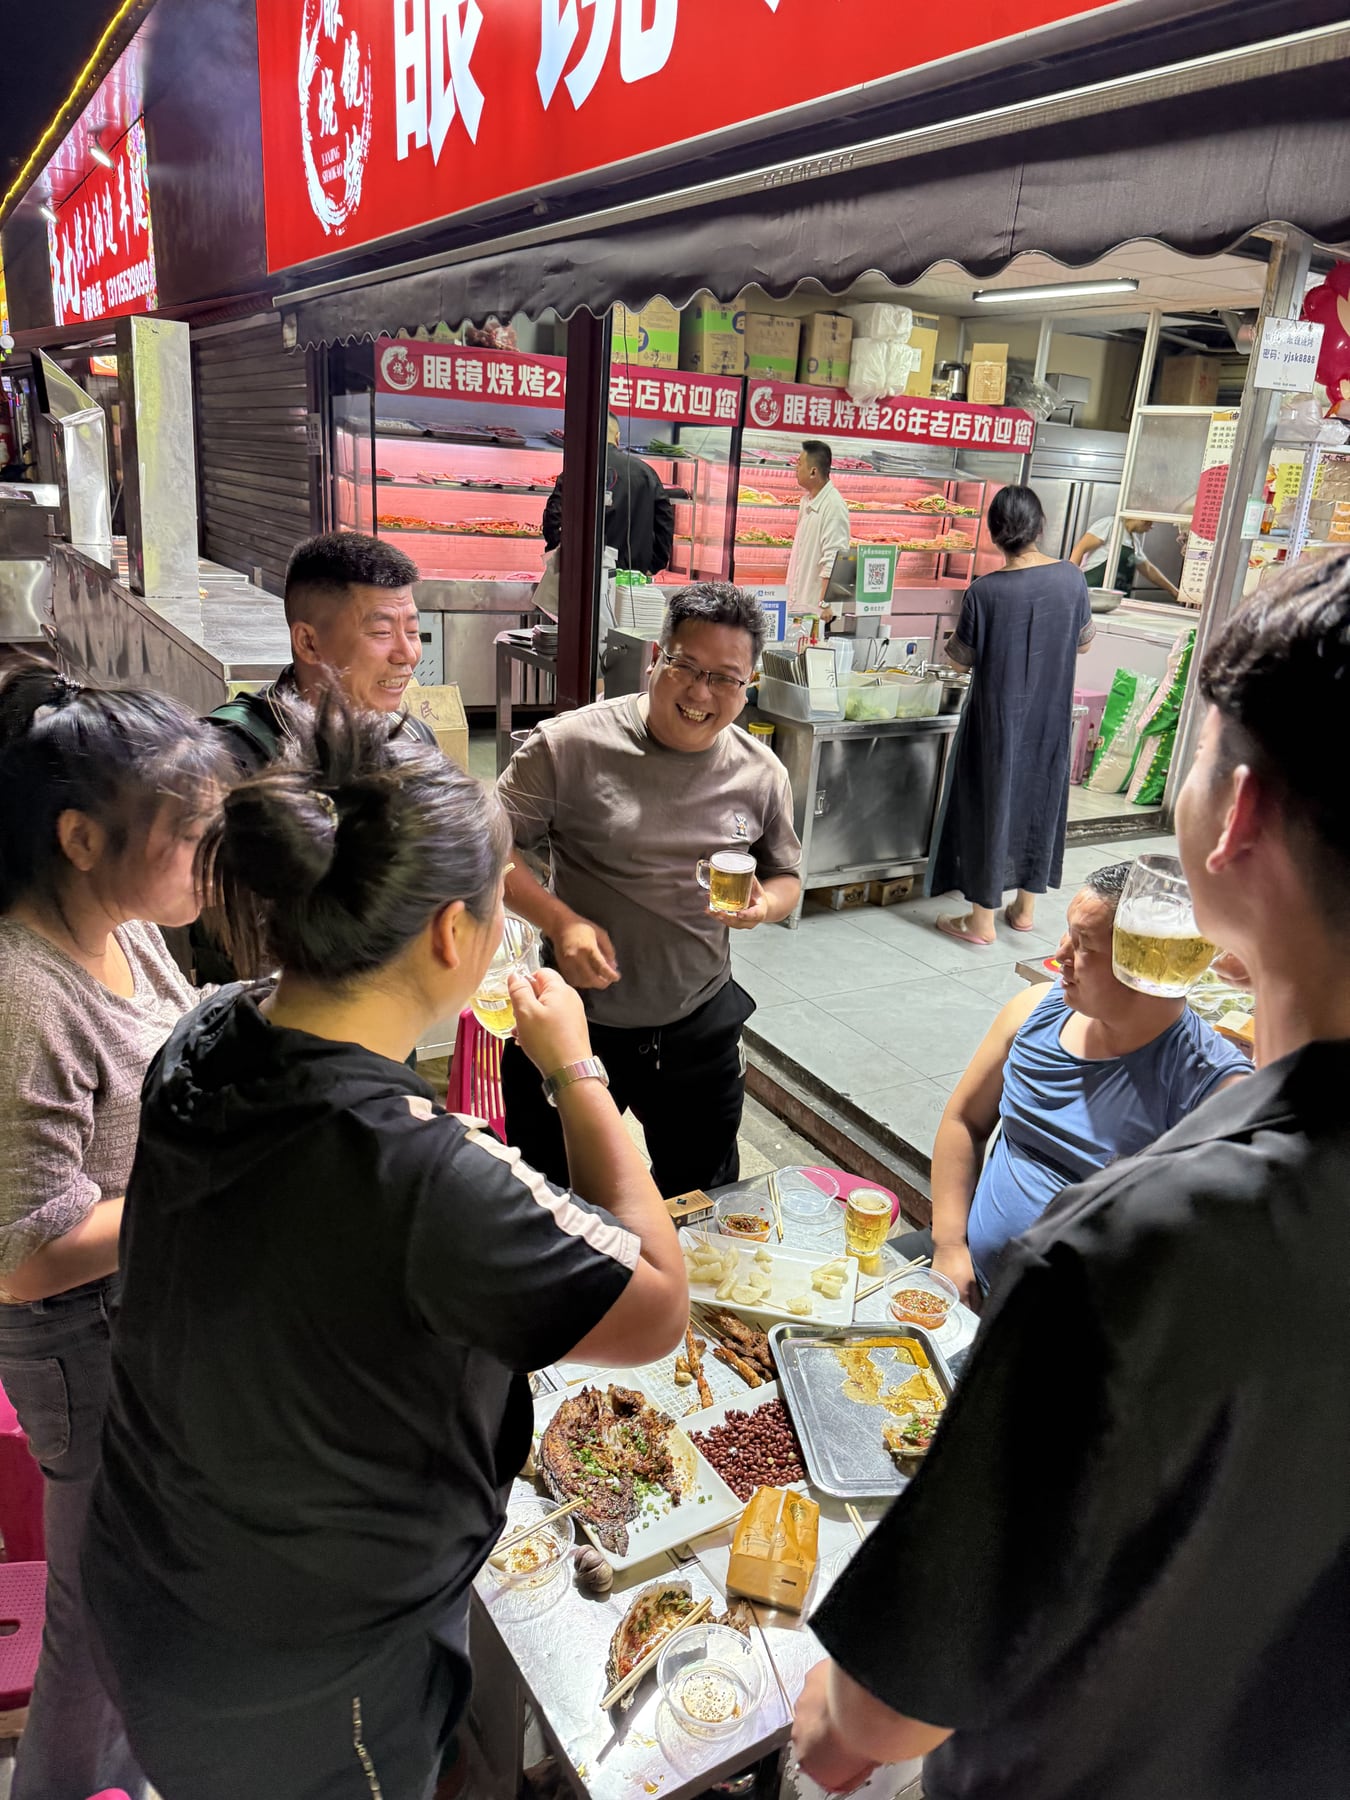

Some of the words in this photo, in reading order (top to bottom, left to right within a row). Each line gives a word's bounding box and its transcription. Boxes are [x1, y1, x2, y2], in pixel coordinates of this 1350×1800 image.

[783, 394, 1033, 446] 眼镜烧烤26年老店欢迎您
